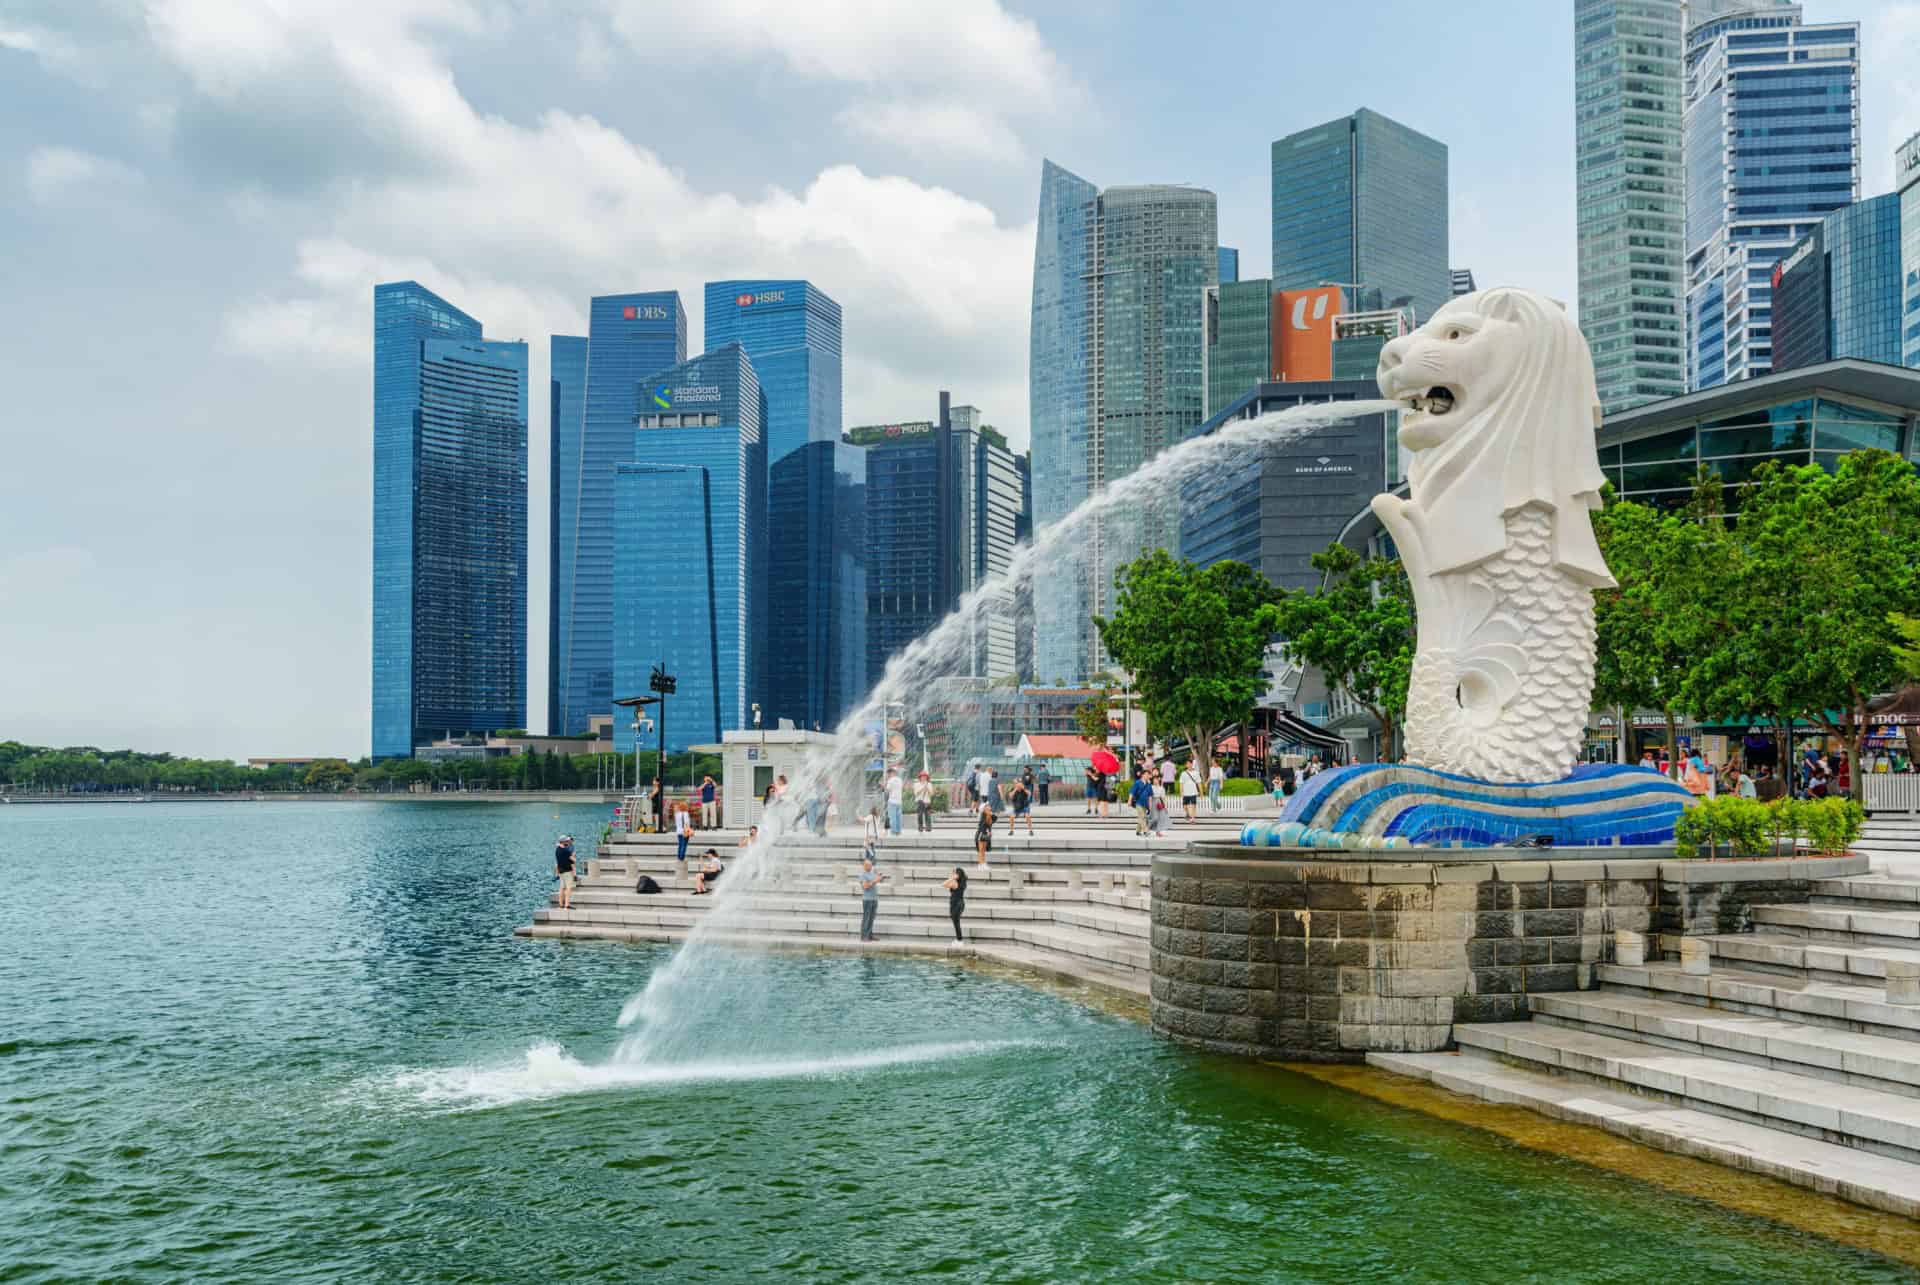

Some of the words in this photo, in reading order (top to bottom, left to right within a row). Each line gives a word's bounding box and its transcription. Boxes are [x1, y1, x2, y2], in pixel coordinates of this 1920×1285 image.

[755, 290, 785, 304] HSBC
[637, 306, 667, 320] DBS
[673, 384, 719, 395] standard
[674, 392, 721, 402] chartered
[1879, 714, 1908, 724] DOG
